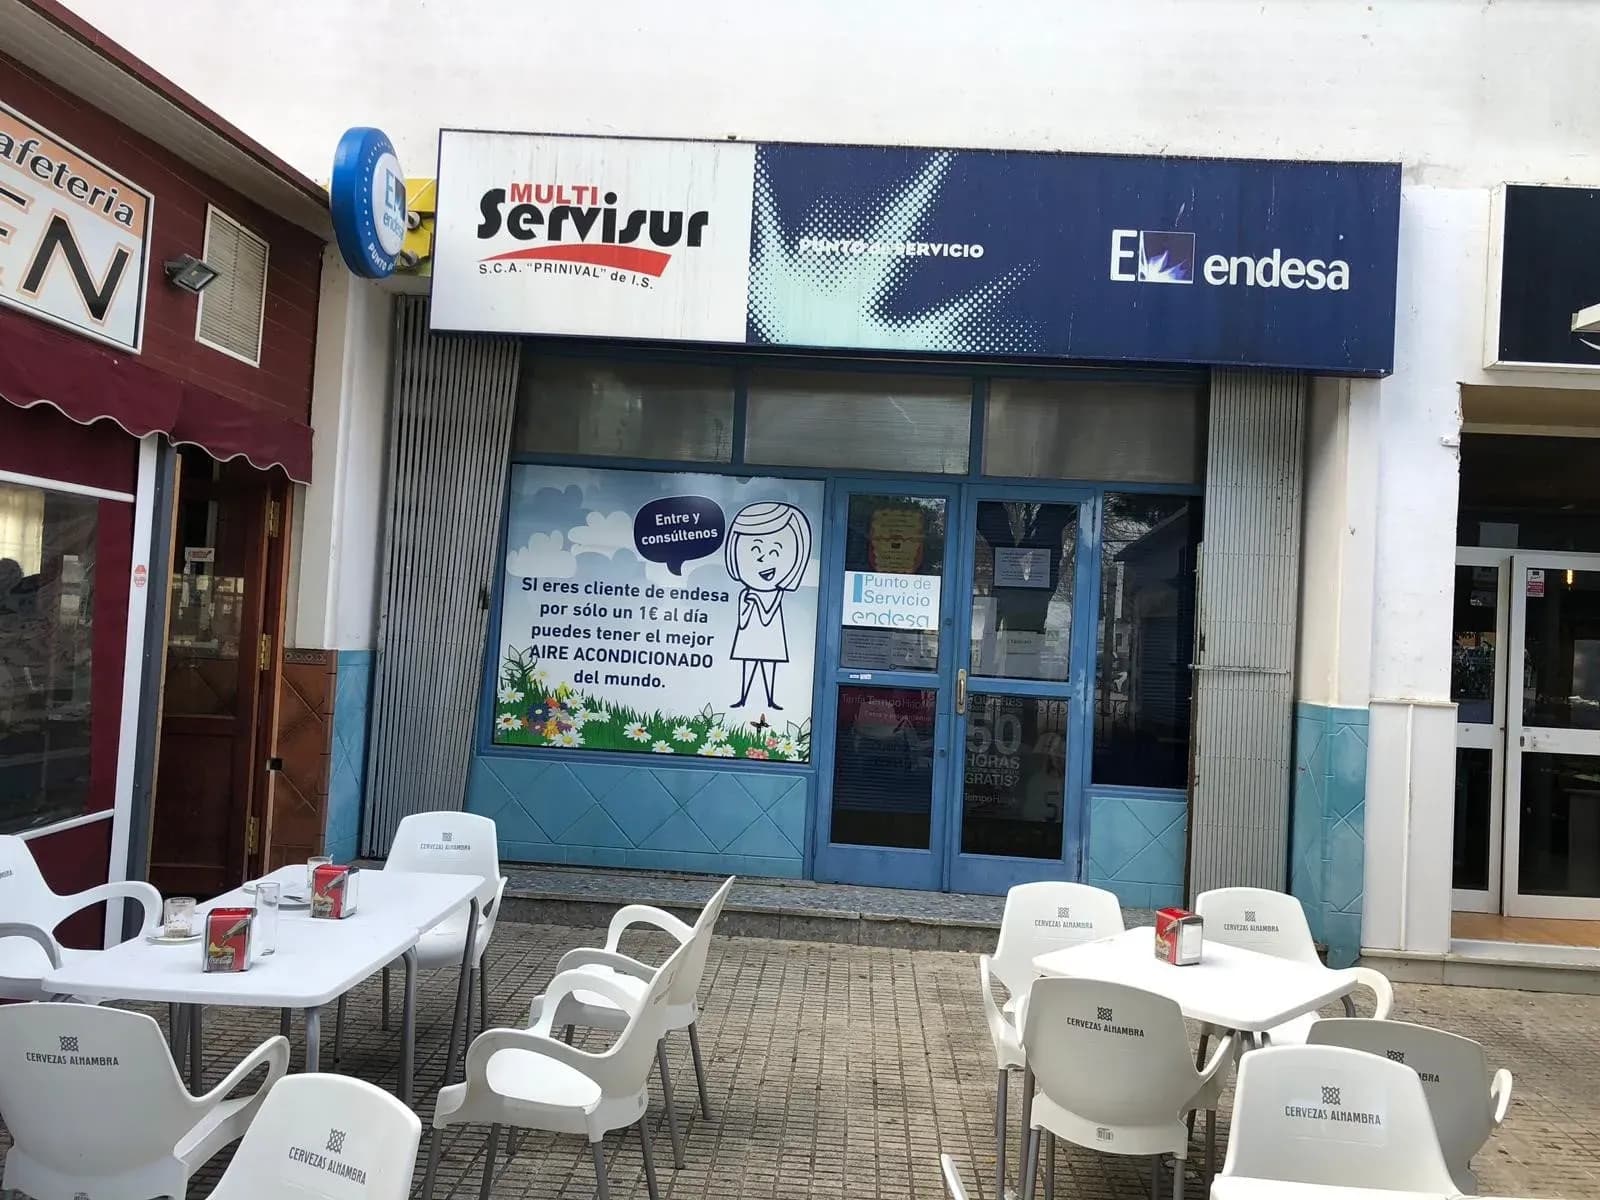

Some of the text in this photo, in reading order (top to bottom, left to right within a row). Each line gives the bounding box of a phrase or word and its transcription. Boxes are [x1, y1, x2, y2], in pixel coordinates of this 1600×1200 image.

[0, 132, 134, 226] afeteria
[510, 183, 598, 206] MULTI
[477, 188, 709, 247] Servisur
[479, 263, 522, 275] S.C.A.
[610, 271, 626, 283] de
[632, 275, 653, 289] I.S.
[1203, 248, 1350, 291] endesa
[655, 512, 701, 527] Entre y
[640, 526, 718, 546] consúltenos
[521, 577, 729, 603] SI eres cliente de endesa
[864, 574, 931, 591] Punto de
[864, 589, 930, 608] Servicio
[539, 602, 708, 624] por sólo un 1€ al día
[851, 609, 930, 628] endesa
[531, 624, 715, 650] puedes tener el mejor
[529, 644, 714, 669] AIRE ACONDICIONADO
[573, 670, 666, 689] del mundo.
[967, 712, 1022, 755] 50
[967, 753, 1021, 769] HORAS
[965, 772, 1020, 787] GRATIS?
[1067, 1016, 1145, 1038] CERVEZAS ALHAMBRA
[26, 1052, 120, 1067] CERVEZAS ALHAMBRA
[1284, 1105, 1382, 1126] CERVEZAS ALHAMBRA
[288, 1146, 367, 1185] CERVEZAS ALHAMBRA
